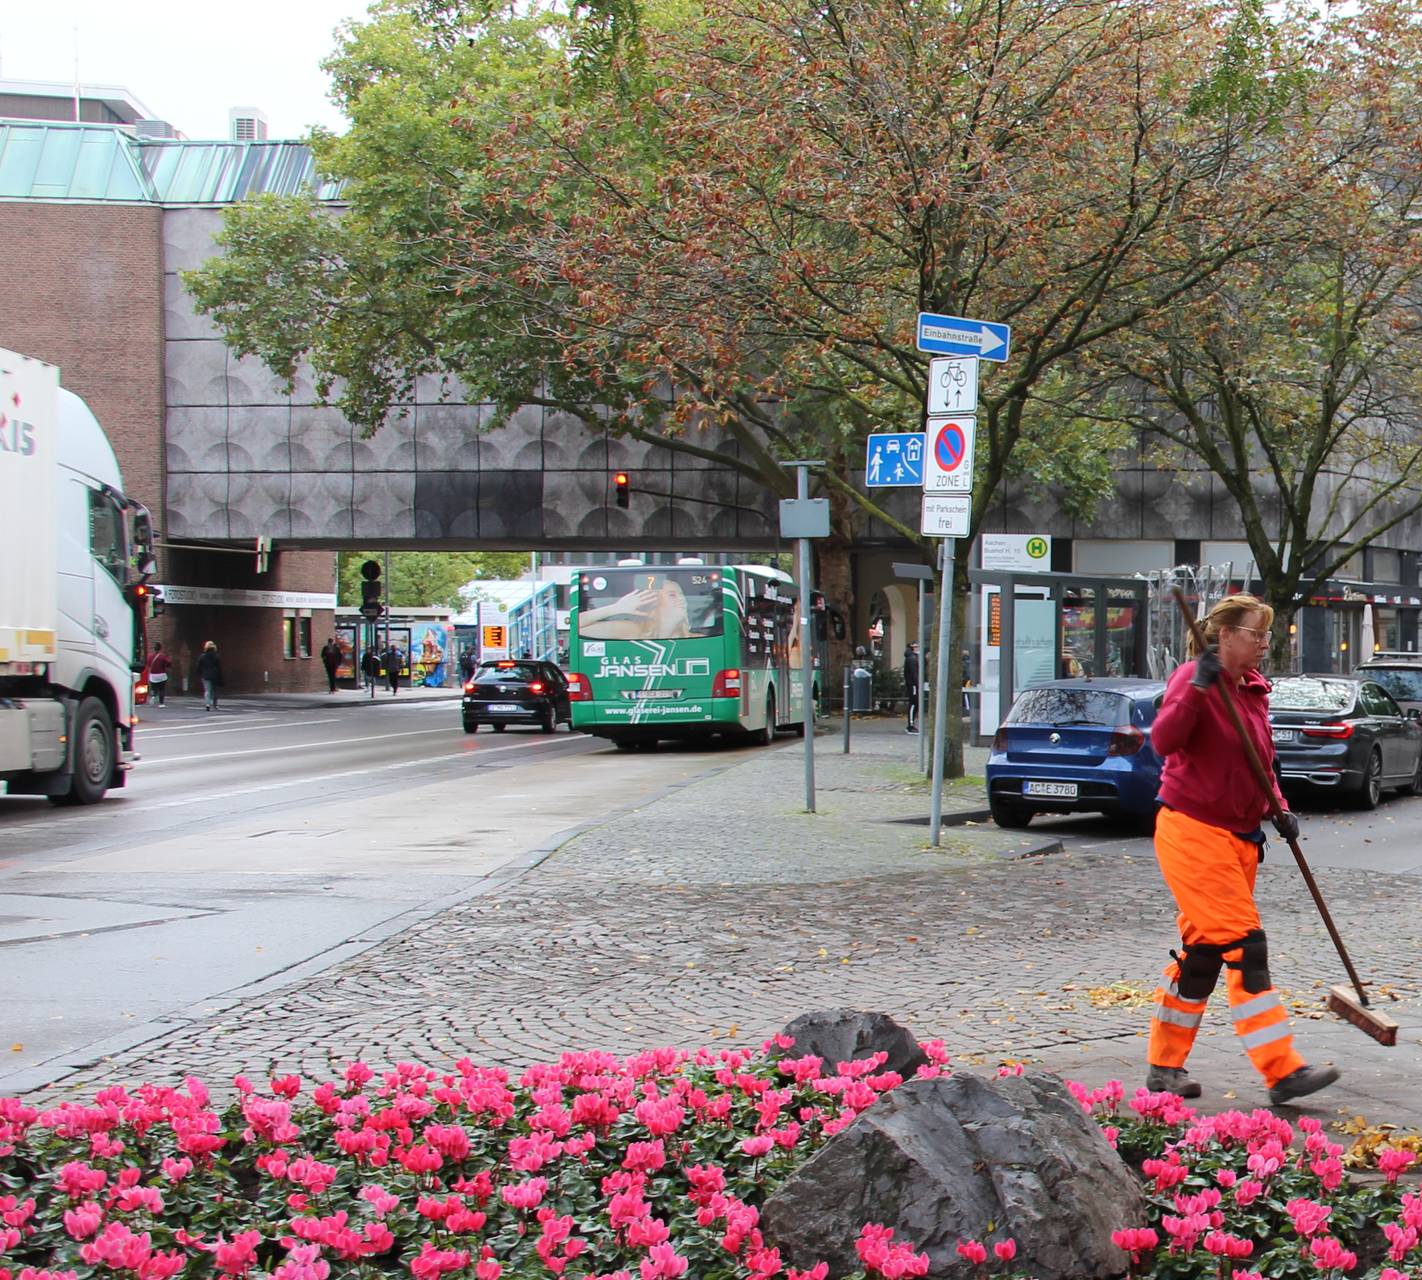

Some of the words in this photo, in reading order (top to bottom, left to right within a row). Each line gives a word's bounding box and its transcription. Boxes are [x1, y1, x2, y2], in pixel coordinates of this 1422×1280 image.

[924, 327, 983, 344] Einbahnstraße
[936, 474, 960, 487] ZONE
[926, 504, 935, 512] mit
[936, 504, 967, 513] Parkschein
[938, 517, 953, 529] frei
[647, 576, 656, 590] 7
[691, 576, 708, 585] 524
[600, 656, 641, 665] GLAS
[594, 664, 677, 678] JANSEN
[605, 704, 702, 715] www.glaserei-jansen.de
[1030, 783, 1040, 793] AC
[1053, 784, 1076, 795] 3780
